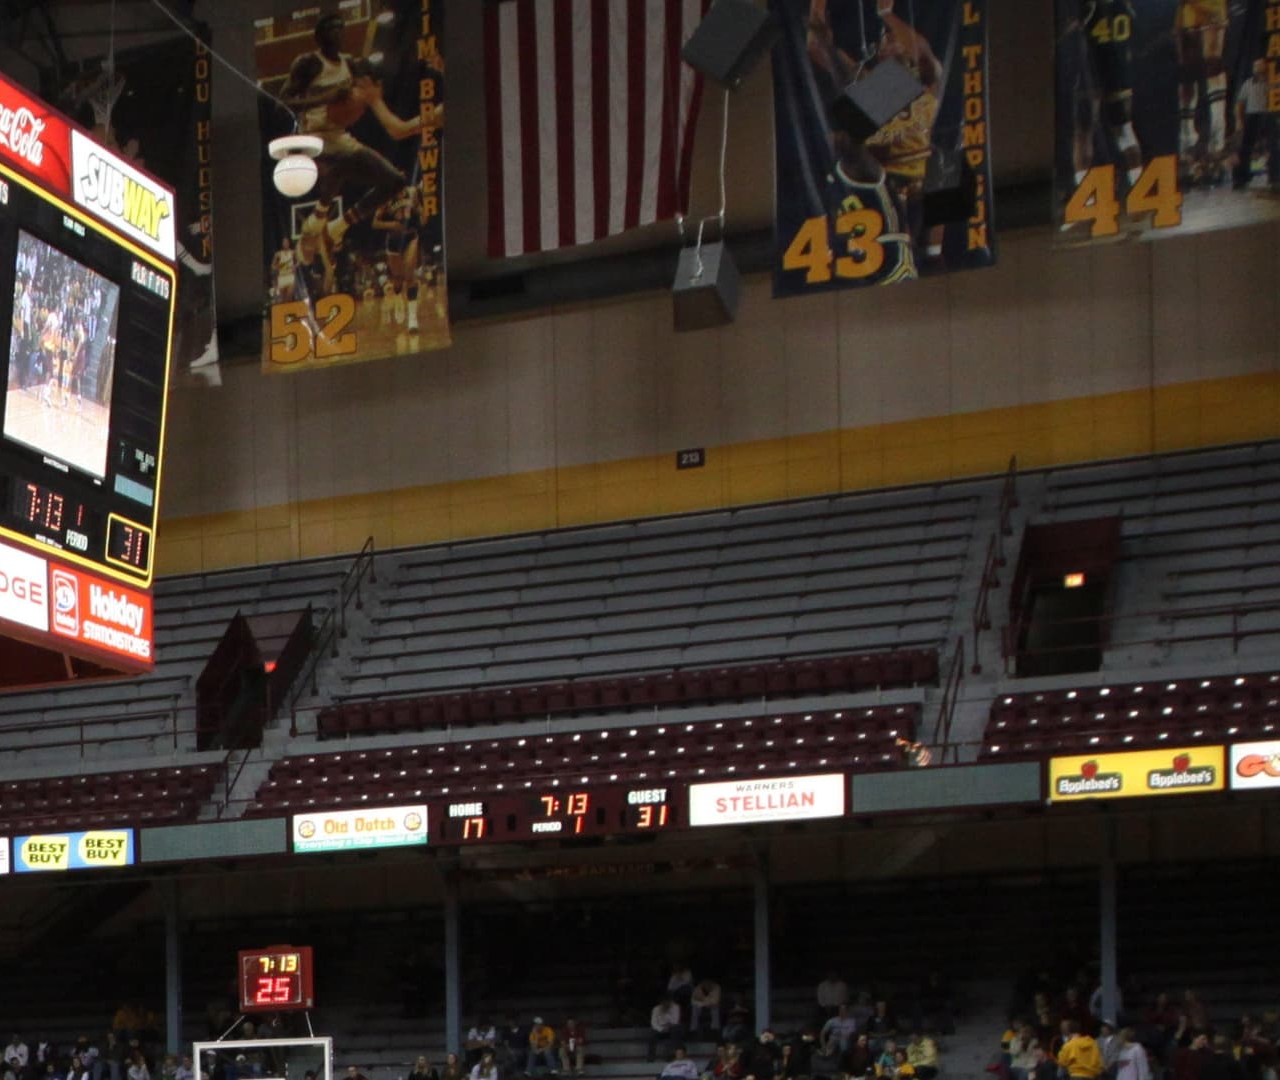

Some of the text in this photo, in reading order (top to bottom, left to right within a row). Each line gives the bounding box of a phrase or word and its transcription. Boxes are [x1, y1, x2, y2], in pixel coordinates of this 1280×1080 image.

[1092, 14, 1132, 43] 40
[419, 77, 439, 225] BREWER
[80, 153, 170, 241] SUBWAY
[1064, 154, 1183, 237] 44
[782, 208, 886, 284] 43
[270, 294, 358, 364] 52
[26, 483, 64, 531] 7:13
[65, 529, 88, 551] PERIOD
[89, 583, 144, 635] Holiday
[628, 789, 667, 804] GUEST
[736, 781, 794, 792] WARNERS
[449, 803, 483, 817] HOME
[541, 794, 587, 816] 7:13
[716, 792, 815, 813] STELLIAN
[324, 814, 396, 835] Old Dutch
[637, 805, 668, 827] 31
[463, 818, 484, 839] 17
[532, 821, 562, 833] PERIOD
[27, 842, 67, 853] BEST
[85, 837, 125, 849] BEST
[29, 853, 63, 864] BUY
[86, 849, 121, 860] BUY
[259, 956, 297, 974] 7:13
[256, 978, 289, 1003] 25
